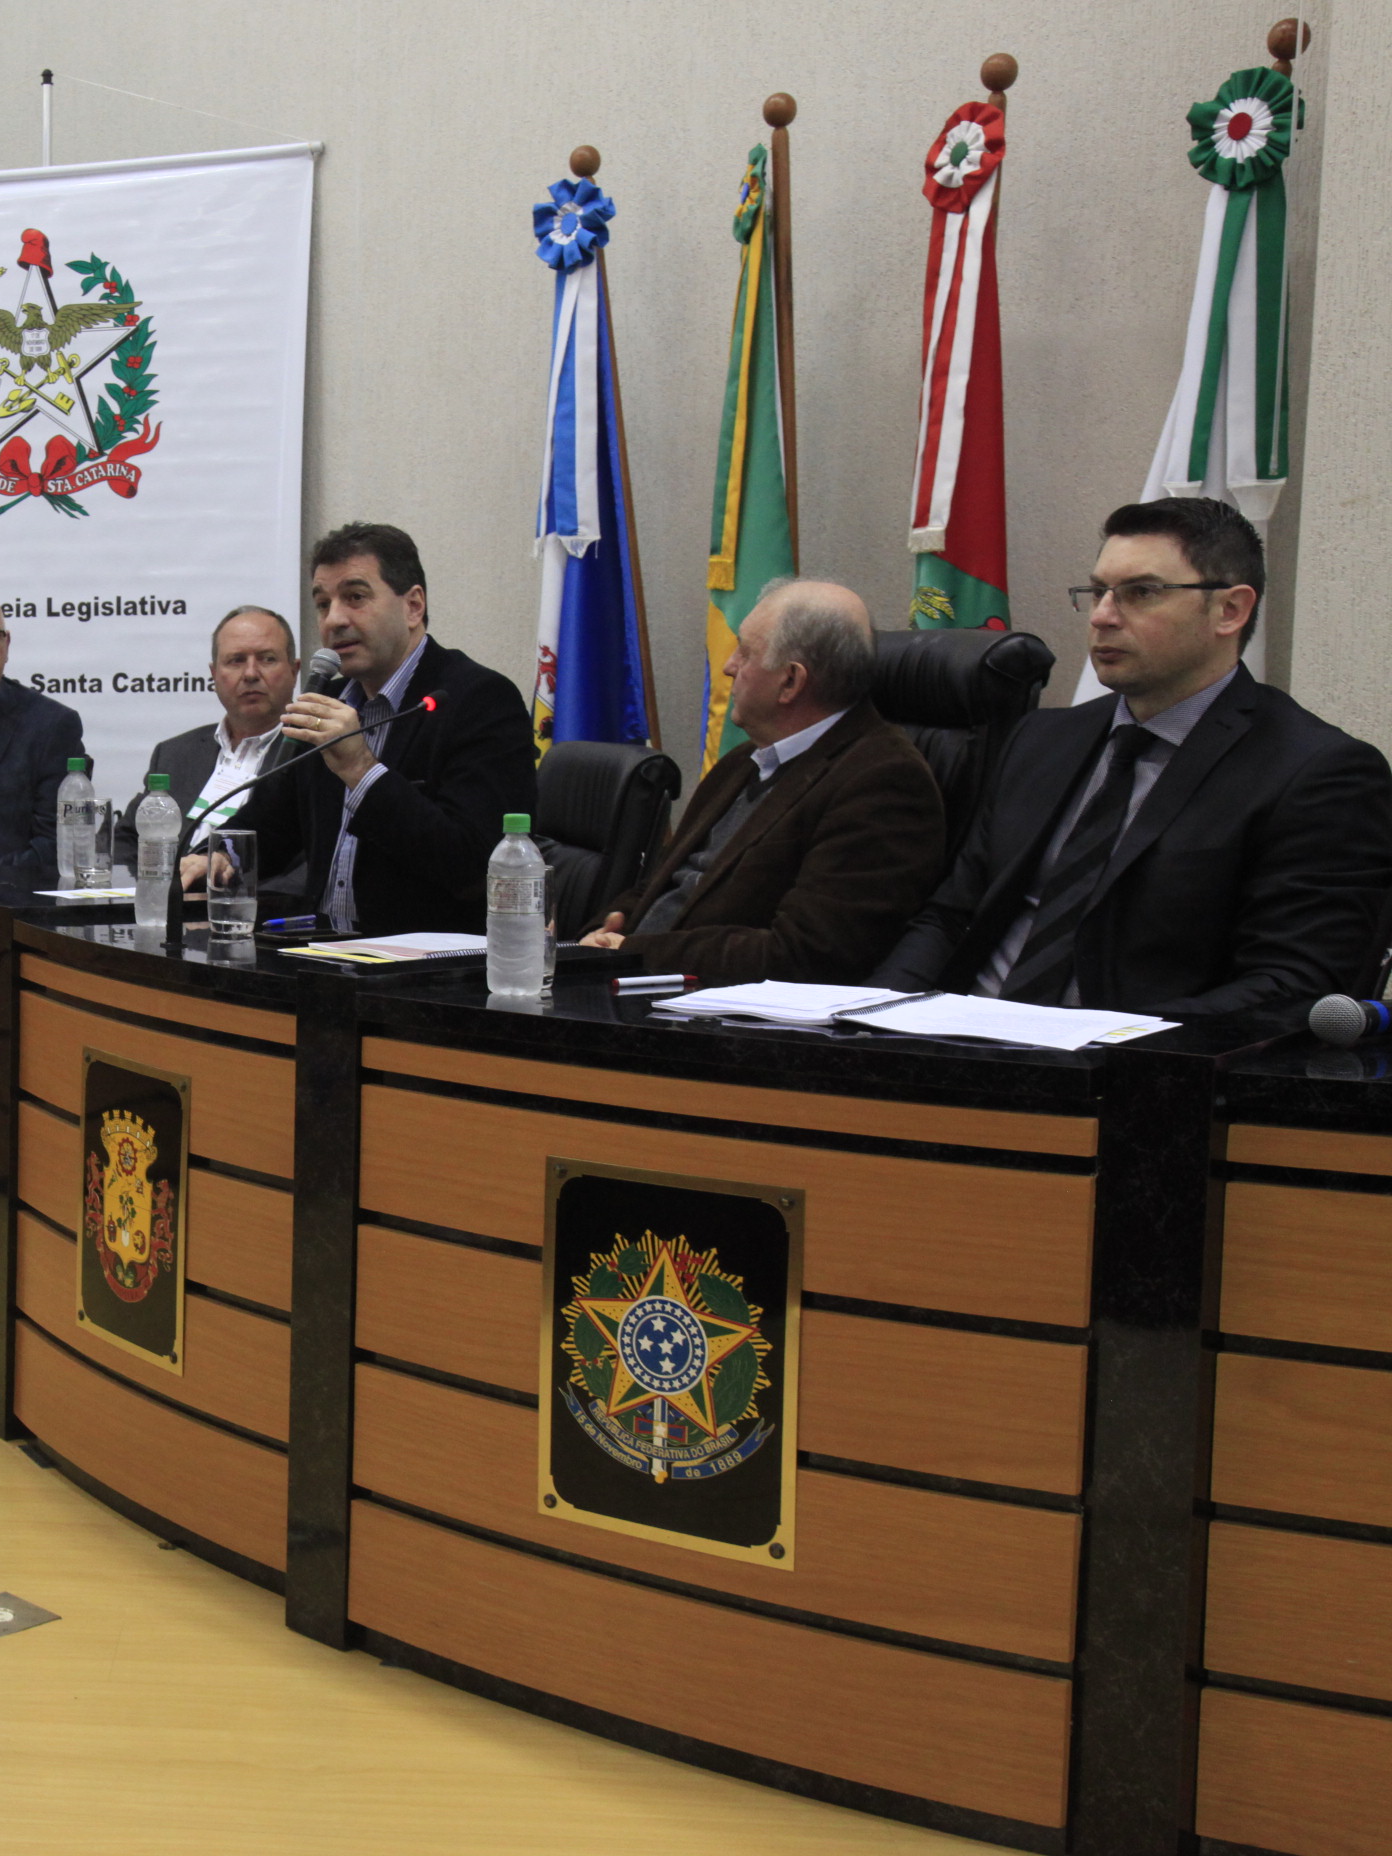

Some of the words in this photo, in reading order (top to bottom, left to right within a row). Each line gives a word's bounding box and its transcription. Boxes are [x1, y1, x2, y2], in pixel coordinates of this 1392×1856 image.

[75, 463, 136, 487] CATARINA
[46, 595, 187, 622] Legislativa
[30, 672, 103, 694] Santa
[574, 1409, 585, 1423] 15
[595, 1432, 643, 1470] Novembro
[710, 1451, 744, 1474] 1889
[635, 1440, 689, 1460] FEDERATIVA
[691, 1447, 704, 1458] DO
[705, 1434, 736, 1454] BRASIL
